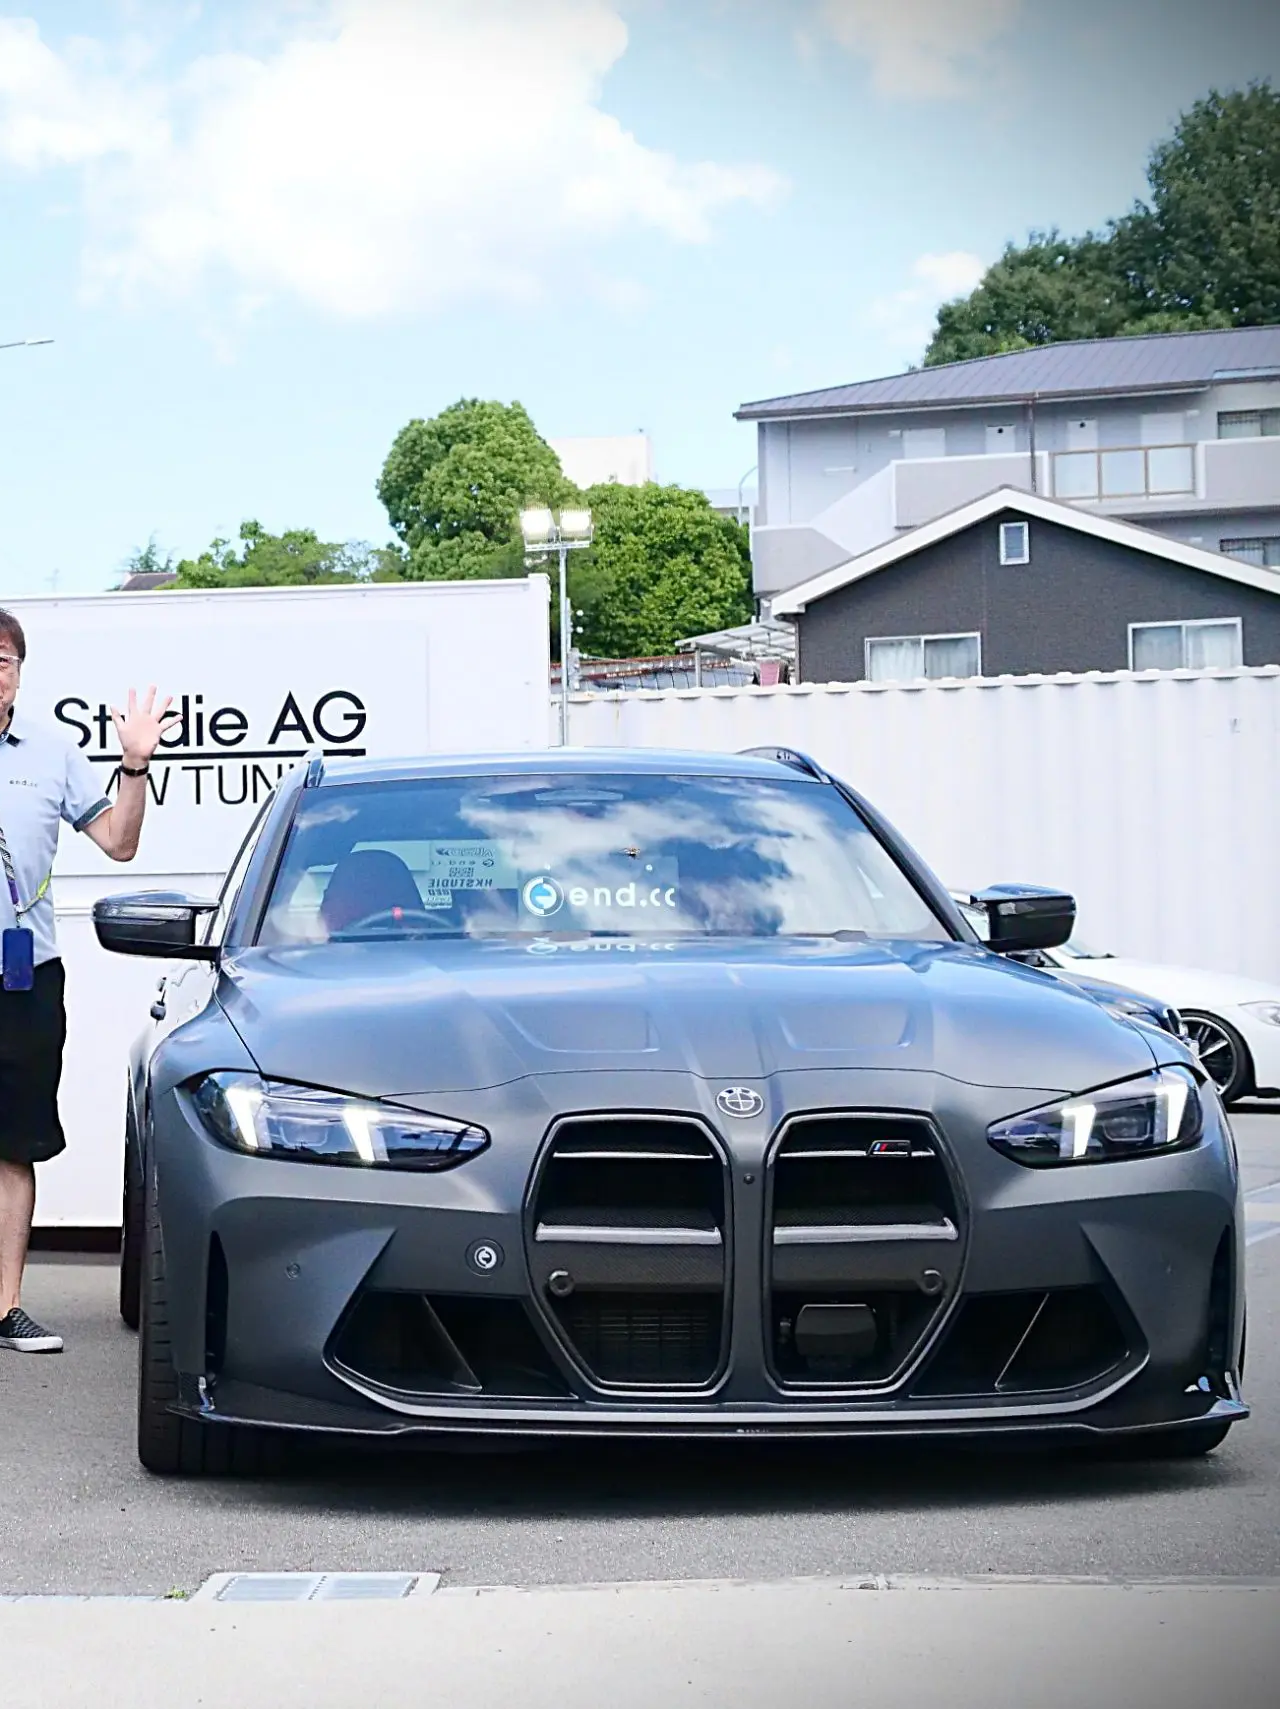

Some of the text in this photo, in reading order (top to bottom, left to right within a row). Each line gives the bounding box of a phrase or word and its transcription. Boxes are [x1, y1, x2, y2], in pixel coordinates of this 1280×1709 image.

[53, 690, 367, 749] Stdie AG
[181, 763, 295, 806] TUN
[569, 882, 676, 907] end.cc
